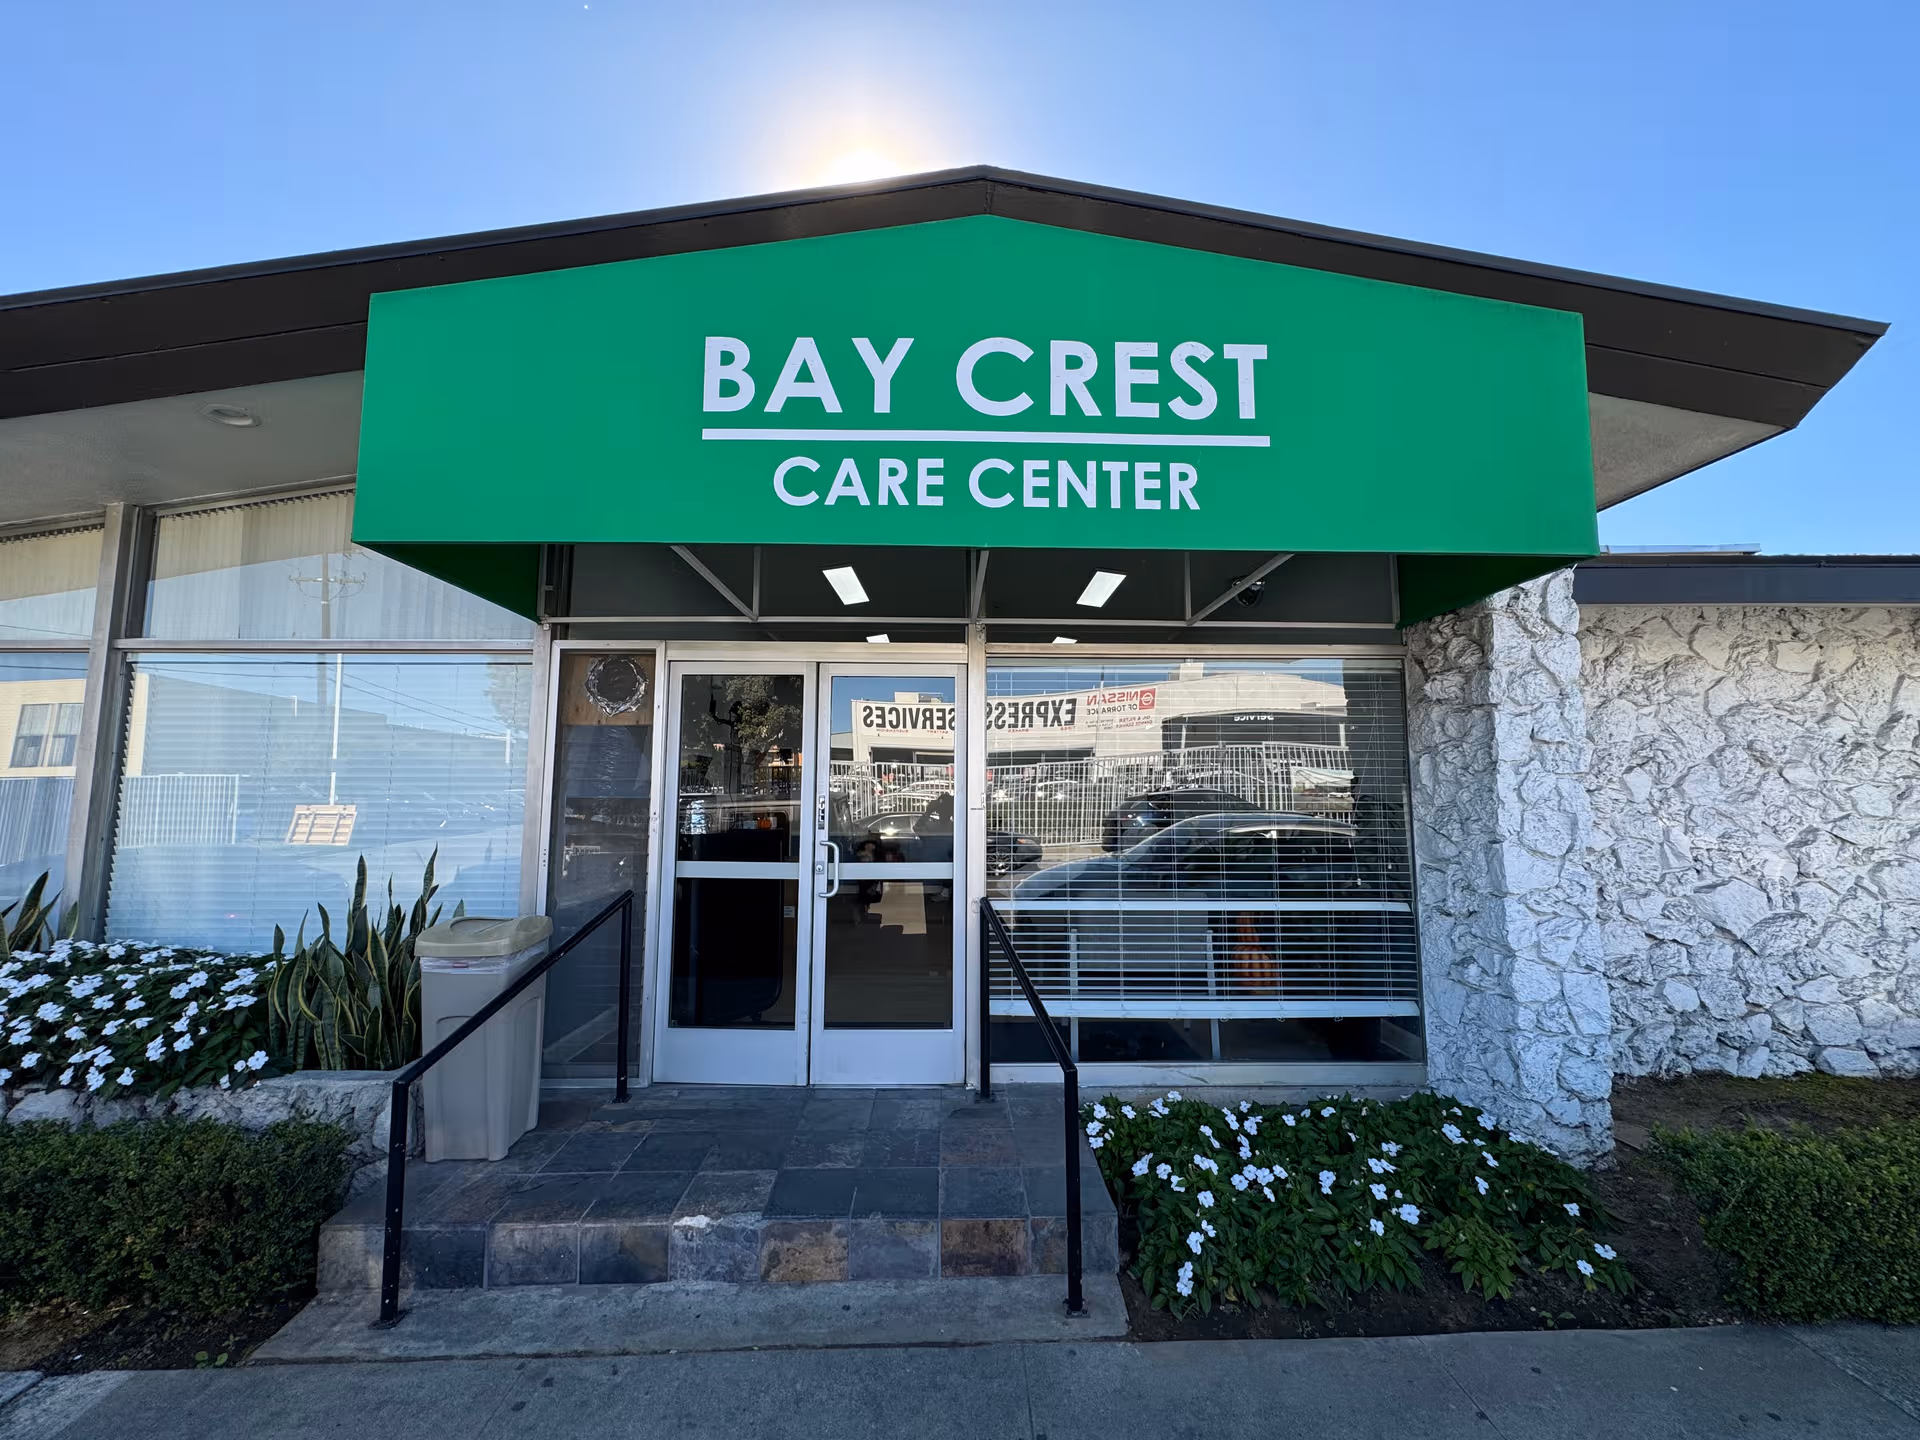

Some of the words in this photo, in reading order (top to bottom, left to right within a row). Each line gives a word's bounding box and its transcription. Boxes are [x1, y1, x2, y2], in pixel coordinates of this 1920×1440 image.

[702, 336, 914, 413] BAY
[956, 337, 1268, 420] CREST
[773, 456, 944, 507] CARE
[968, 458, 1200, 511] CENTER
